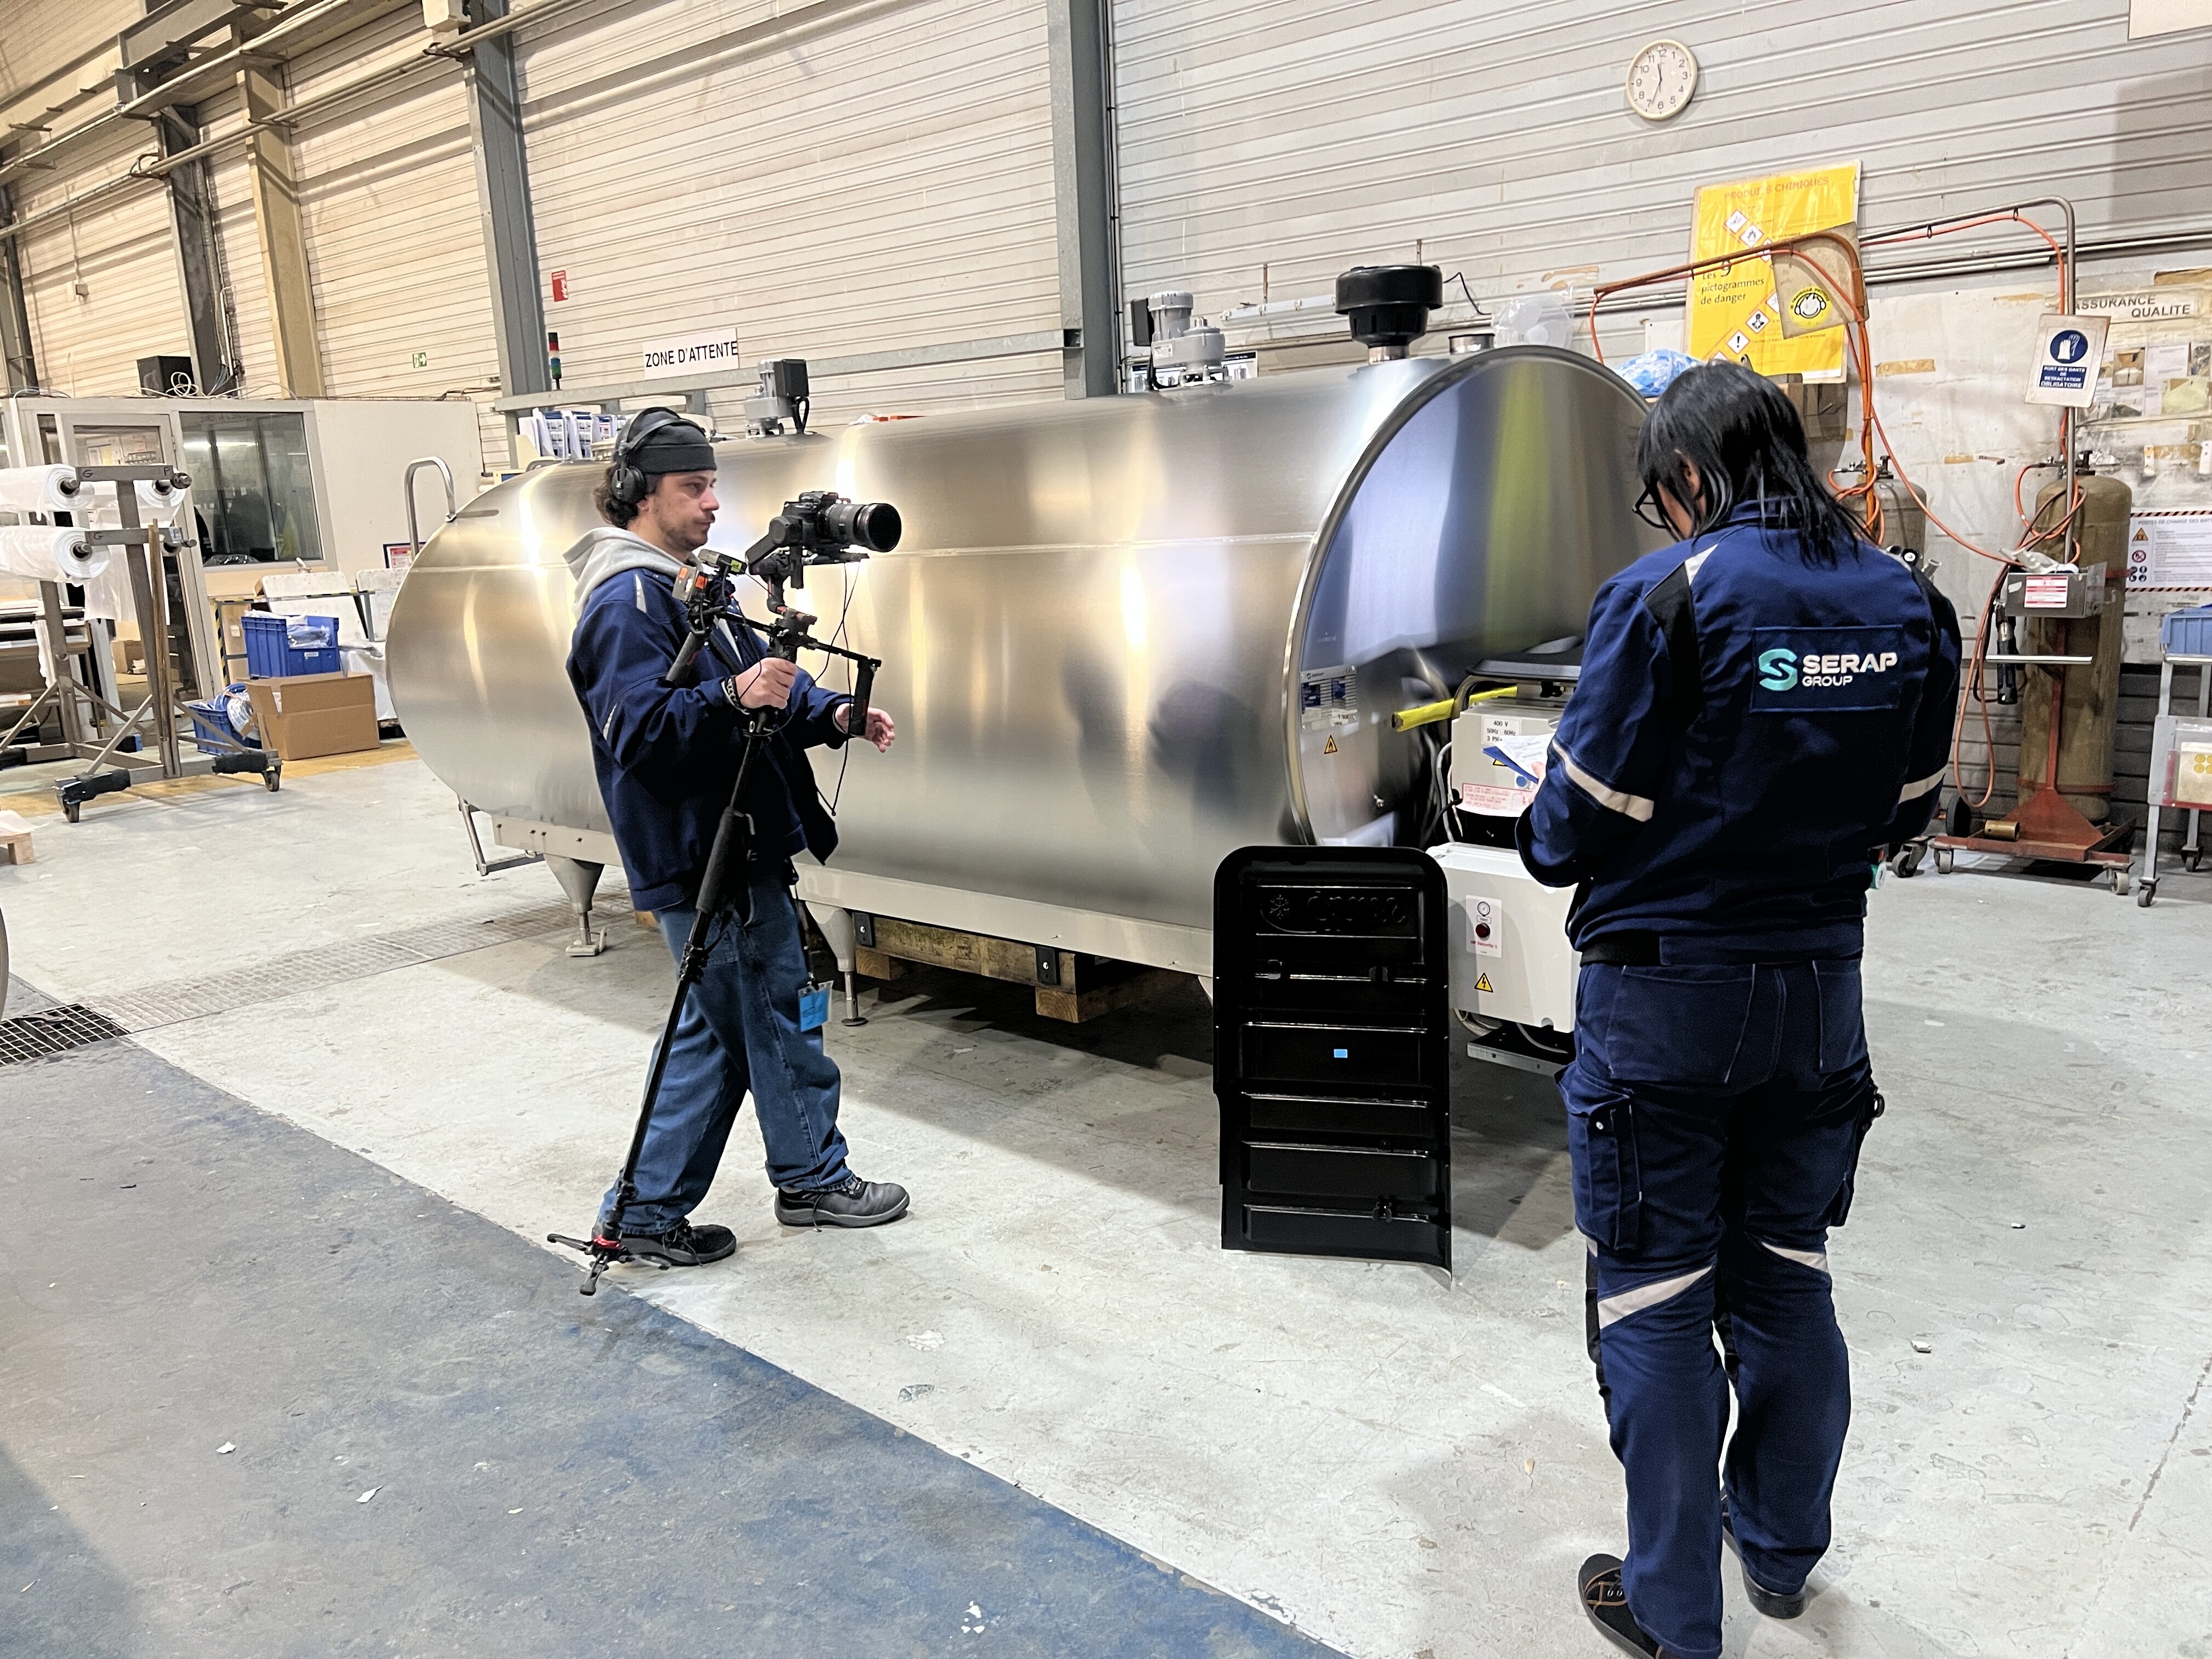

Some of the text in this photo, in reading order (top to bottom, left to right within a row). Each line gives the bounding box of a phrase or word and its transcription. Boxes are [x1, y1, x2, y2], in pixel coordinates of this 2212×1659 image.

[1659, 48, 1667, 58] 12
[1672, 51, 1675, 59] 1
[1648, 55, 1655, 63] 11
[1679, 59, 1685, 68] 2
[1639, 65, 1650, 74] 10
[1682, 71, 1688, 80] 3
[1635, 78, 1642, 87] 9
[1639, 91, 1645, 99] 8
[1670, 95, 1675, 104] 5
[1646, 99, 1651, 108] 7
[1657, 101, 1664, 109] 6
[1724, 176, 1829, 201] PRODUIS CHIMIQUES
[1702, 278, 1764, 295] pictogrammes
[1701, 294, 1746, 305] de danger
[2131, 303, 2191, 319] QUALITE
[645, 340, 738, 368] ZONE D'ATTENTE
[83, 466, 171, 478] G P
[93, 532, 103, 540] G
[1802, 652, 1898, 675] SERAP
[1802, 675, 1853, 687] GROUP
